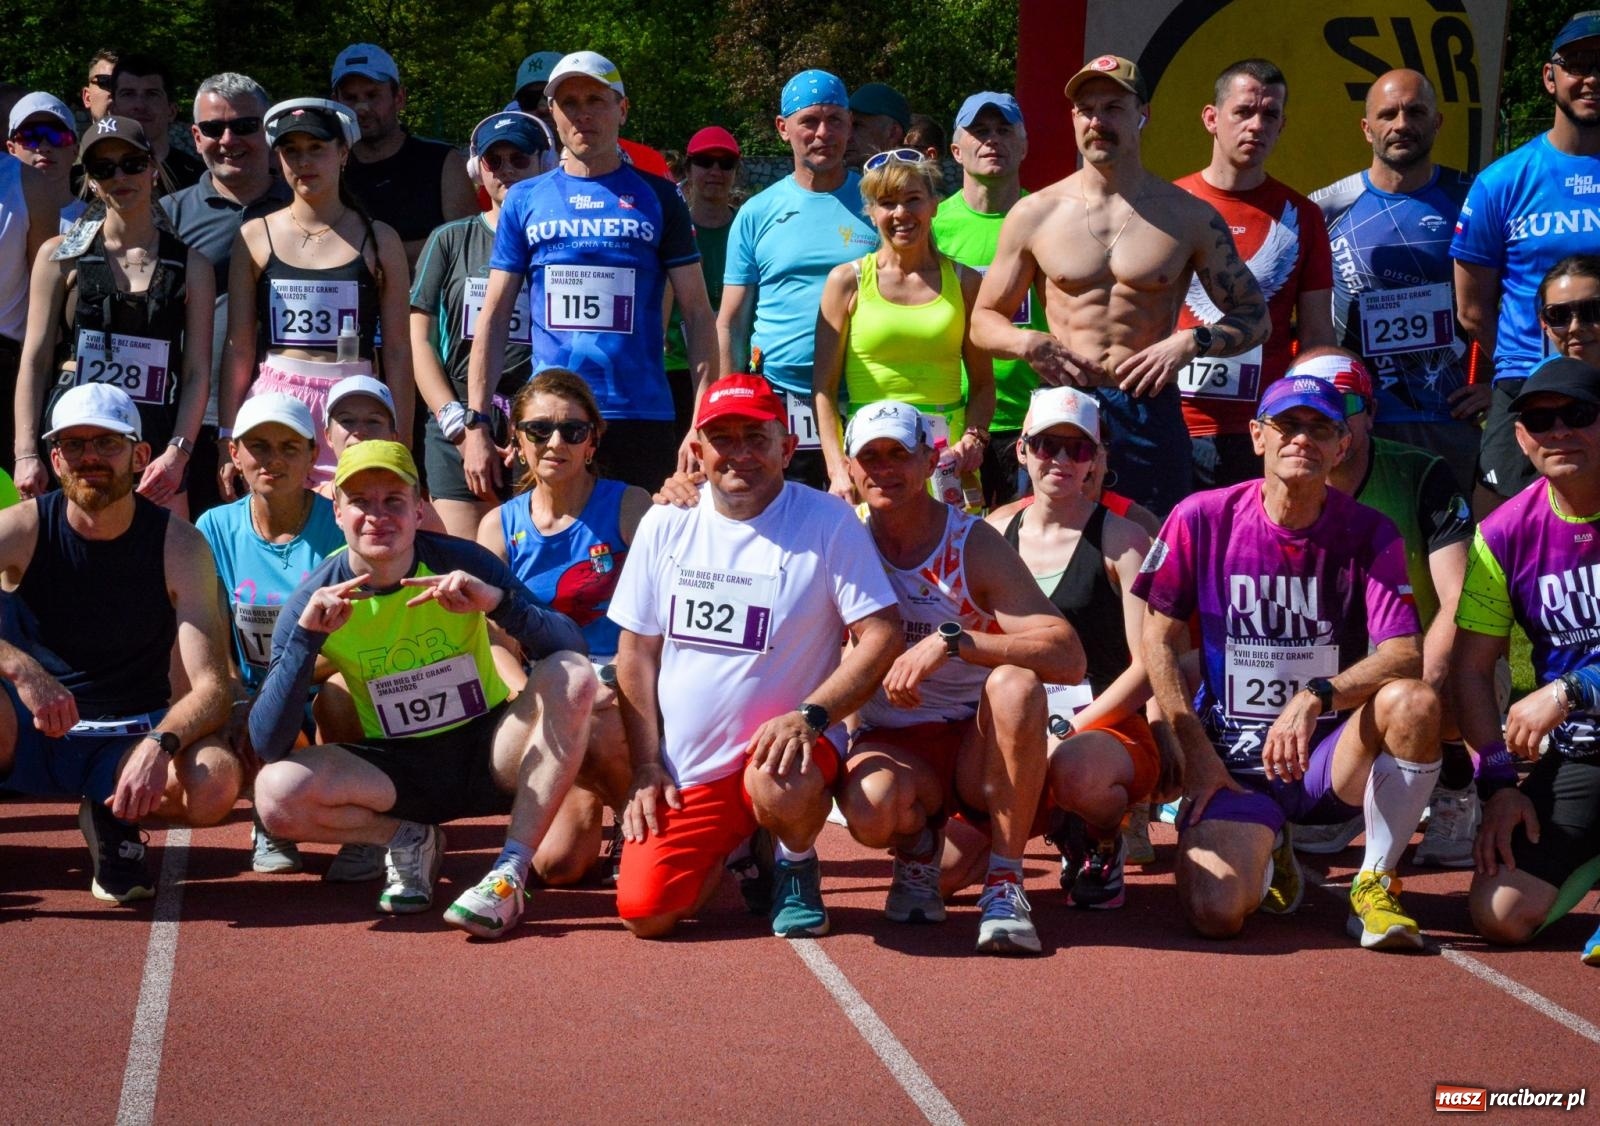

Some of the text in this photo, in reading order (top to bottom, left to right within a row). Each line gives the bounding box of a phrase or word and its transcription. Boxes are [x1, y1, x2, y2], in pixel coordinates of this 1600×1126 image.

[526, 218, 655, 247] RUNNERS
[602, 240, 630, 249] TEAM
[550, 278, 583, 286] 3MAJA2026
[565, 270, 579, 278] BIEG
[592, 271, 615, 280] GRANIC
[289, 285, 303, 293] BIEG
[315, 286, 339, 294] GRANIC
[1408, 289, 1432, 299] GRANIC
[562, 294, 600, 319] 115
[281, 309, 332, 335] 233
[1374, 314, 1428, 343] 239
[117, 338, 129, 347] BEZ
[129, 340, 152, 350] GRANIC
[87, 360, 142, 390] 228
[1188, 362, 1229, 388] 173
[678, 577, 715, 590] 3MAJA2026
[680, 568, 753, 586] XVIII BIEG BEZ GRANIC
[686, 598, 735, 634] 132
[906, 620, 932, 635] BIEG
[1233, 650, 1315, 661] XVIII BIEG BEZ GRANIC
[1233, 658, 1275, 668] 3MAJA2026
[375, 665, 453, 691] XVIII BIEG BEZ GRANIC
[377, 683, 418, 697] 3MAJA2026
[1246, 678, 1300, 708] 231
[394, 691, 448, 726] 197
